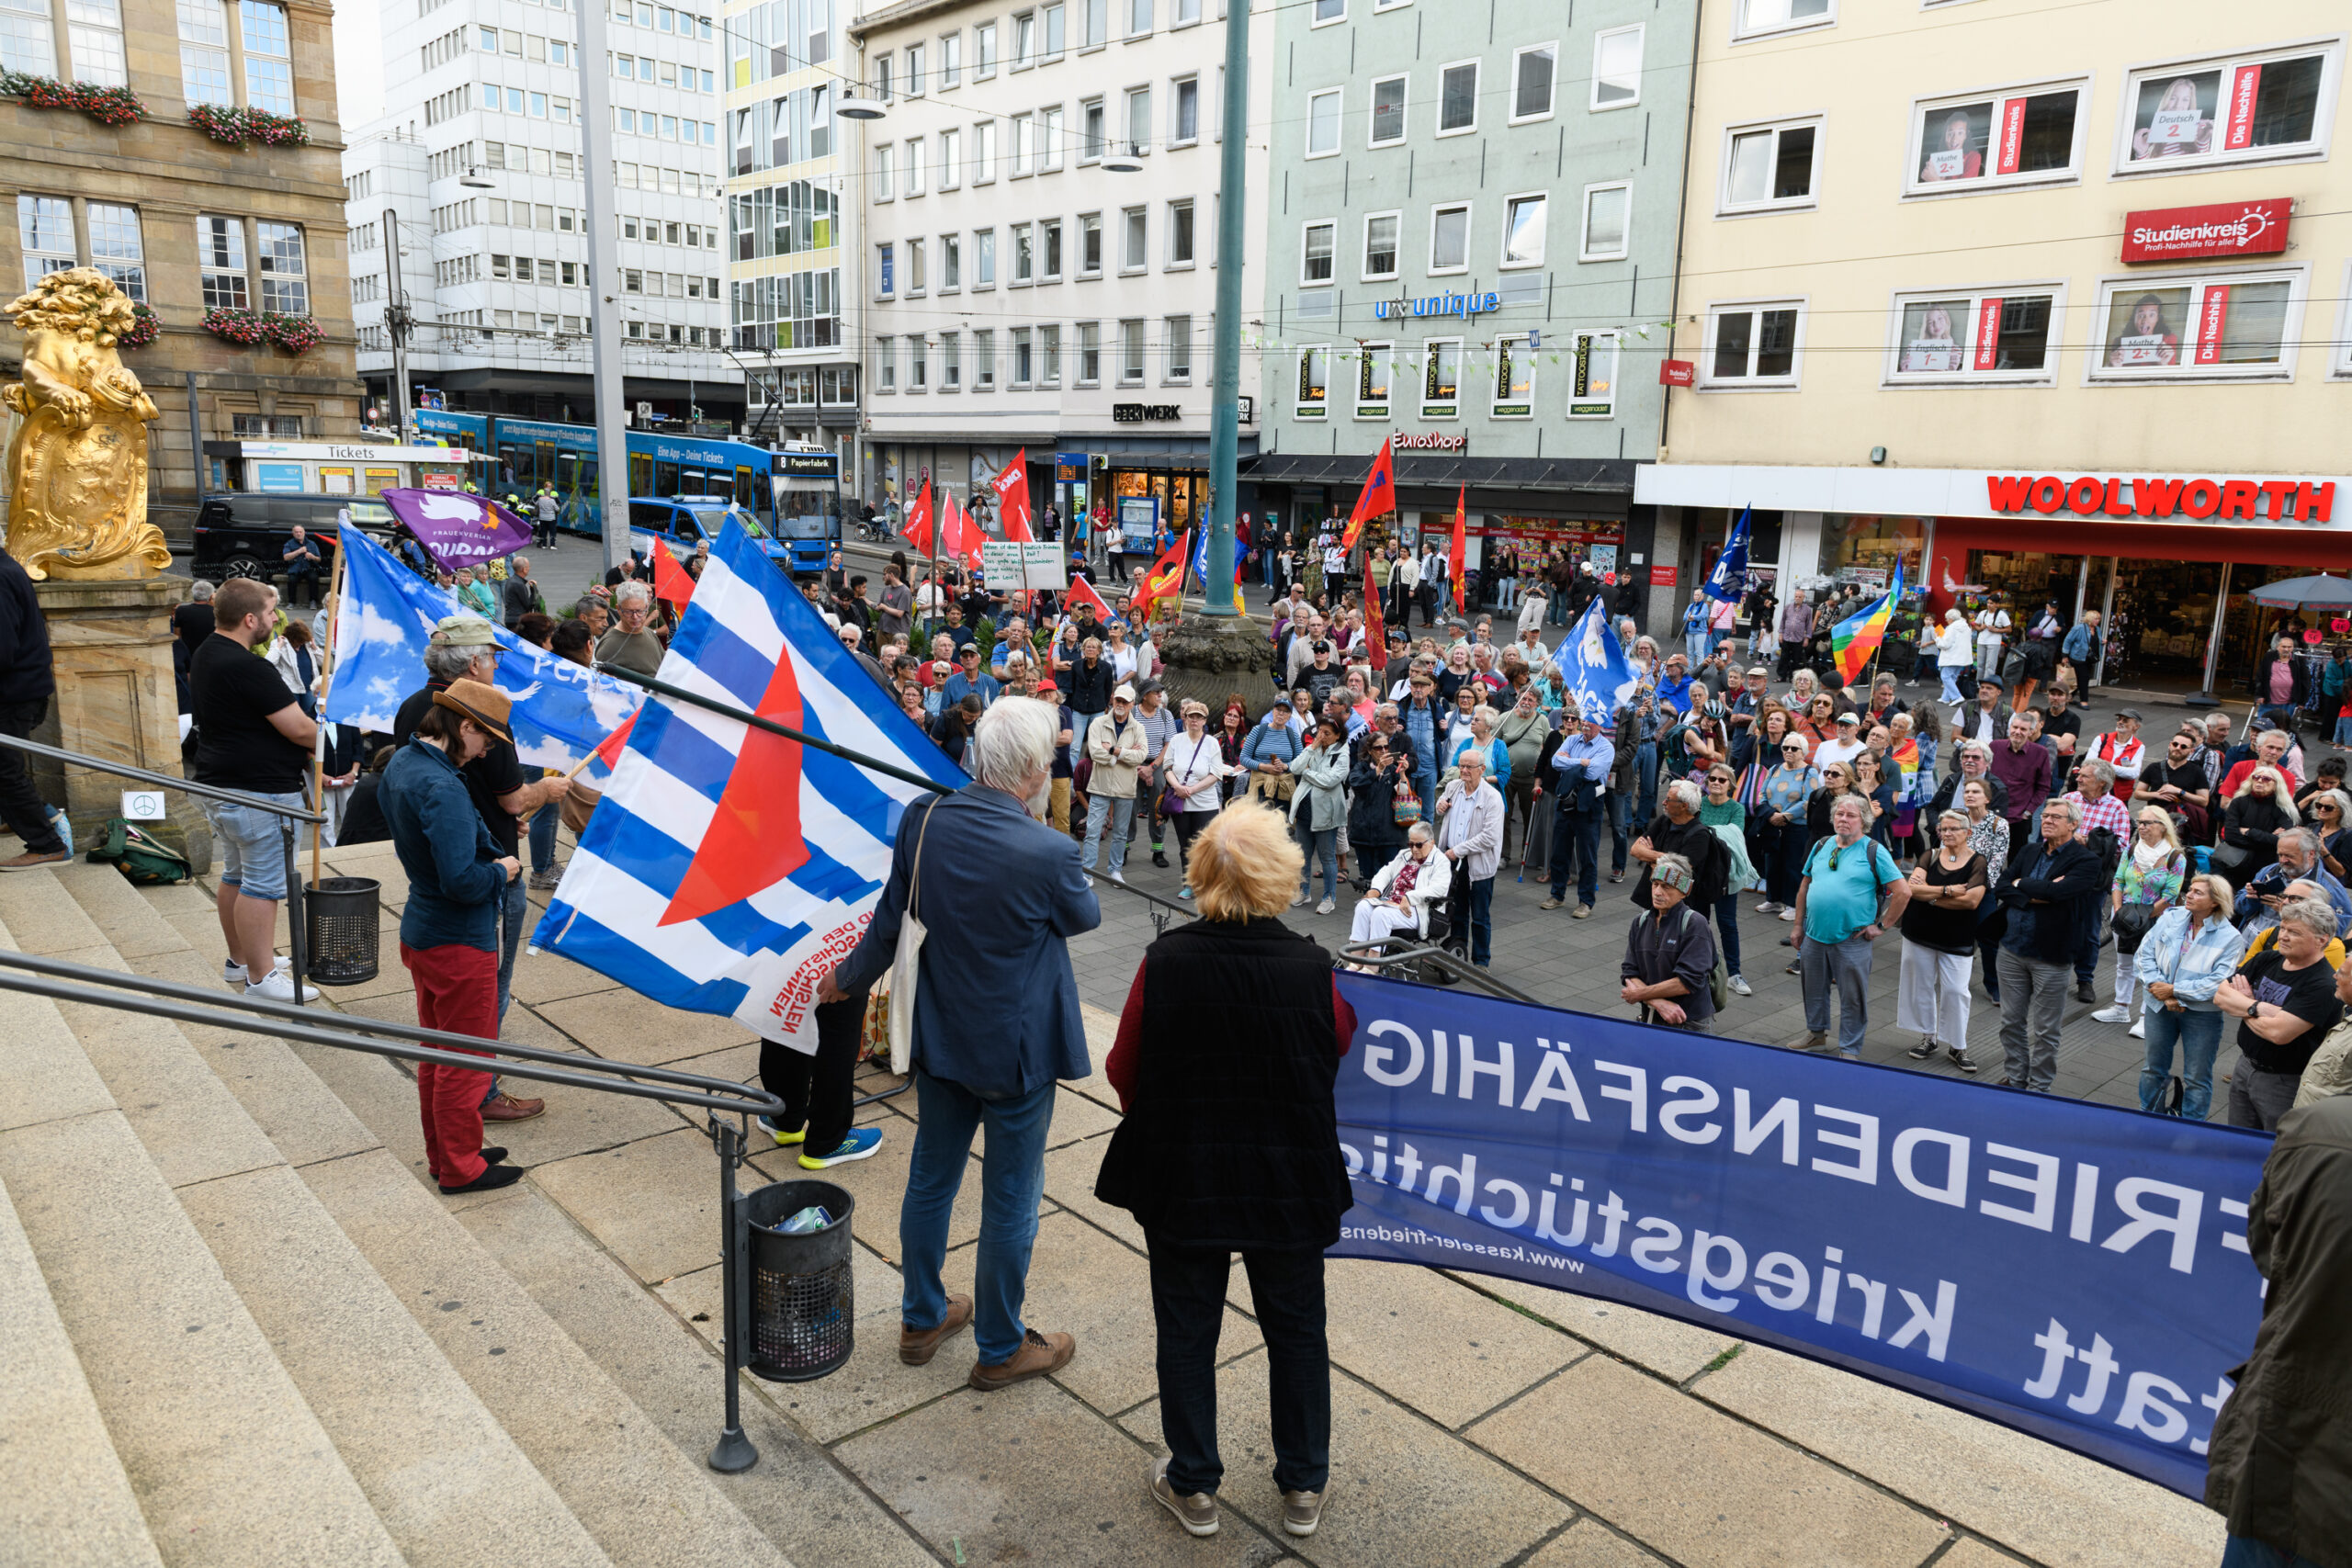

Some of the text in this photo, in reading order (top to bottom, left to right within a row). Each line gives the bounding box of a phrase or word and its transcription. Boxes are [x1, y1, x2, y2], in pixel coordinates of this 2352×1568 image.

[2233, 72, 2254, 144] Die Nachhilfe
[2159, 114, 2194, 124] Deutsch
[2004, 106, 2020, 167] Studienkreis
[2167, 124, 2180, 137] 2
[1936, 154, 1958, 163] Mathe
[1939, 163, 1954, 173] 2+
[2132, 220, 2248, 244] Studienkreis
[2144, 240, 2203, 252] Profi-Nachhilfe
[2218, 238, 2235, 246] alle!
[1413, 289, 1501, 320] unique
[2202, 291, 2222, 359] Die Nachhilfe
[1530, 332, 1540, 345] W
[1980, 305, 1996, 364] Studienkreis
[1916, 344, 1947, 353] Englisch
[2132, 348, 2150, 359] 2+
[1577, 336, 1588, 396] TATTOOSTUDIO
[328, 446, 375, 459] Tickets
[658, 446, 670, 457] Eine
[670, 447, 680, 461] App
[685, 449, 702, 462] Deine
[703, 451, 724, 464] Tickets
[781, 457, 829, 468] 8 Papierfabrik
[1987, 476, 2335, 522] WOOLWORTH
